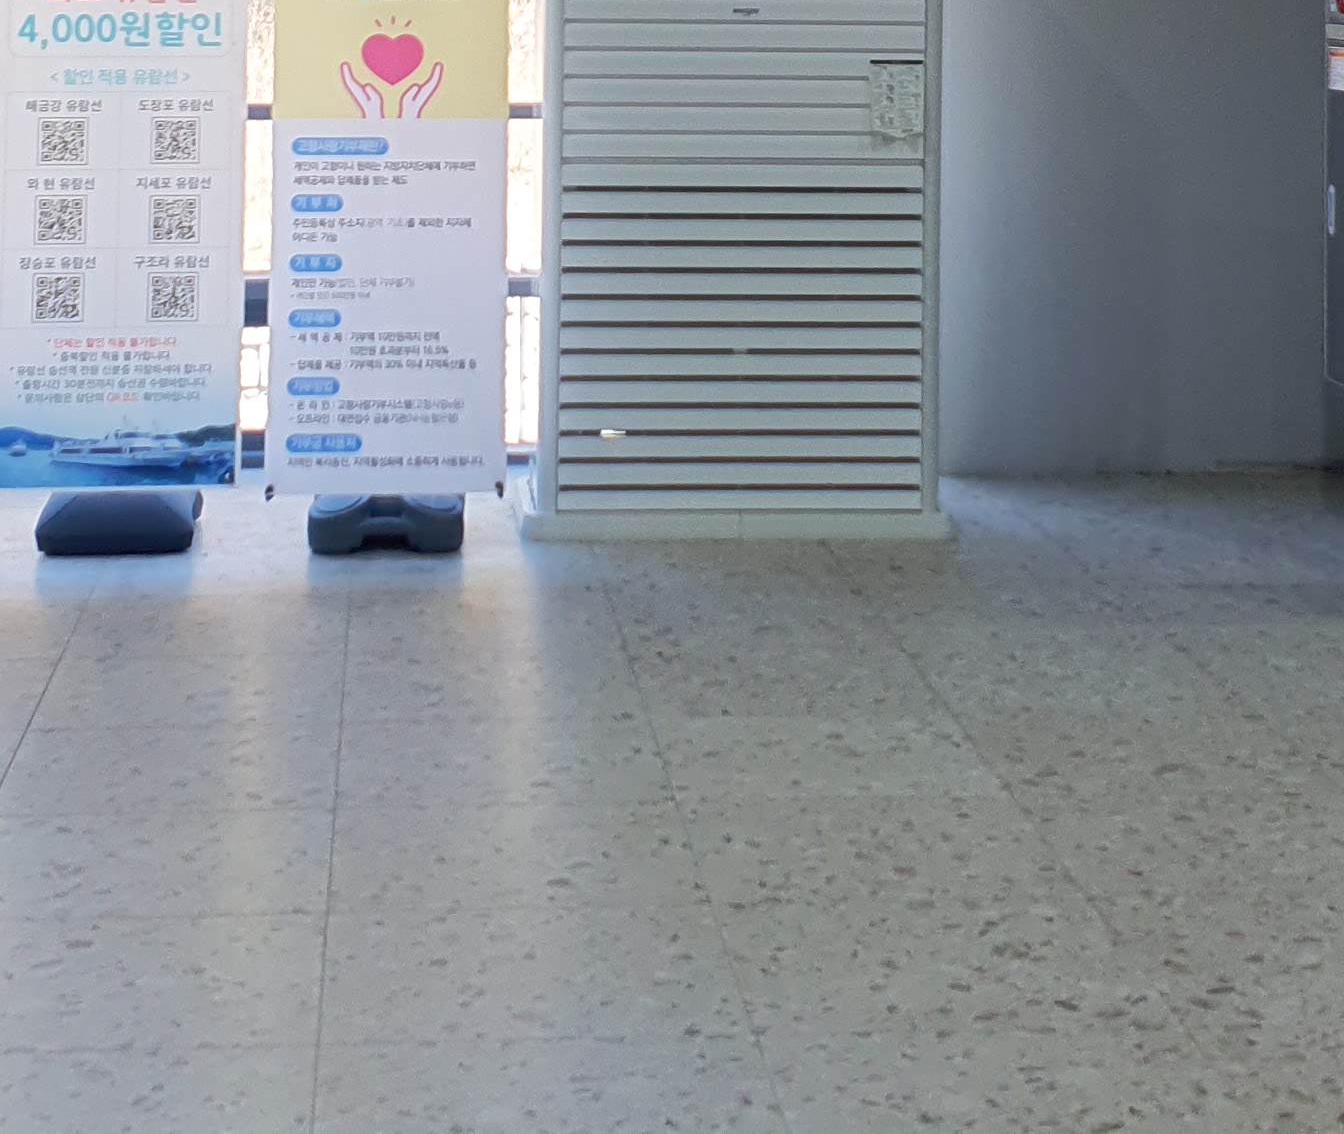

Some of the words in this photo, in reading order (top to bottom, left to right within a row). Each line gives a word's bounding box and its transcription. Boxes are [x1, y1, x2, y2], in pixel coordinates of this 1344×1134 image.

[64, 68, 94, 86] 할인
[98, 68, 127, 86] 적용
[133, 68, 179, 86] 유람선
[25, 98, 63, 113] 해금강
[65, 98, 103, 113] 유람선
[138, 98, 175, 112] 도장포
[178, 98, 215, 112] 유람선
[59, 177, 96, 191] 유람선
[135, 176, 172, 190] 지세포
[175, 176, 212, 190] 유람선
[18, 256, 56, 270] 장승포
[59, 256, 97, 270] 유람선
[134, 255, 170, 269] 구조라
[173, 255, 211, 269] 유람선
